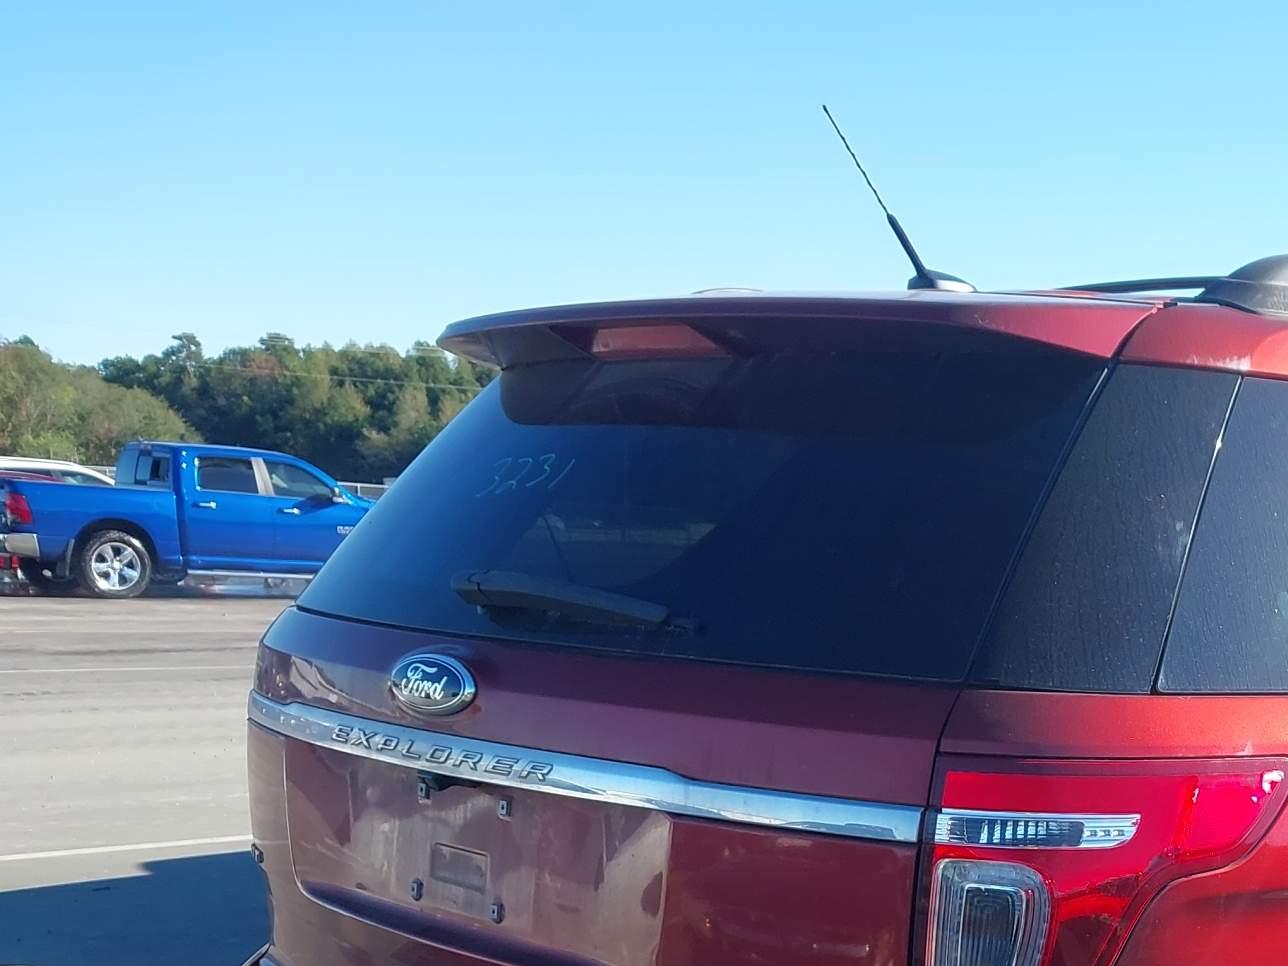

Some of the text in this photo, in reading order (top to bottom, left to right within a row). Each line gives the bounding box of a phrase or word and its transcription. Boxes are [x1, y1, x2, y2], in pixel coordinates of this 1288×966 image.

[475, 452, 576, 497] 3231
[401, 662, 448, 700] Ford
[331, 724, 554, 782] EXPLORER
